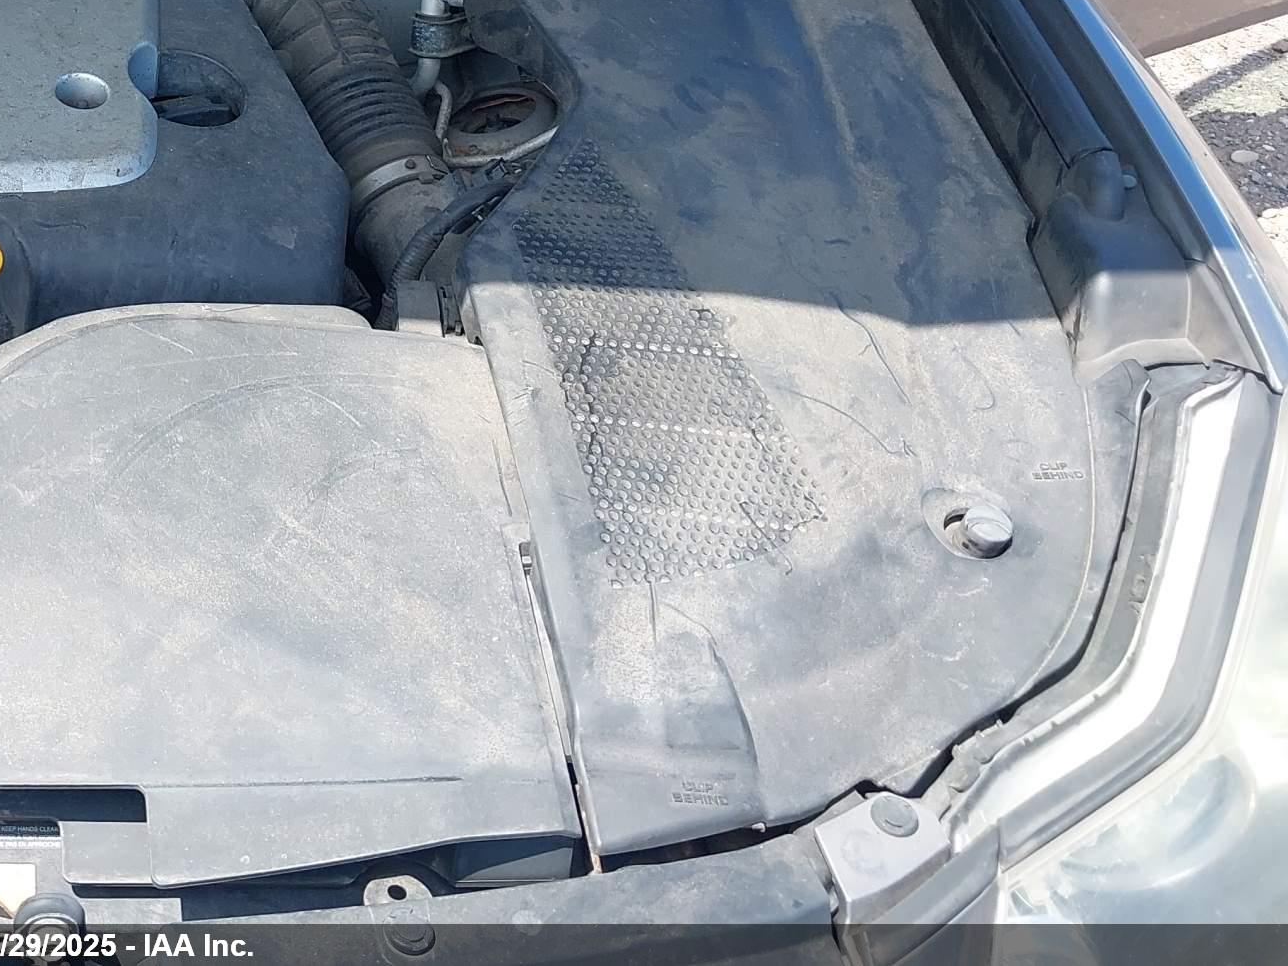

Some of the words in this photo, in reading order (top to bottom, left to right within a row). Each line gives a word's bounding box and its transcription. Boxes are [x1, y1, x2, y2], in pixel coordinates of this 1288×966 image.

[1039, 461, 1069, 471] CLIP
[1031, 470, 1085, 481] BEHIND
[681, 781, 715, 793] CLIP
[671, 791, 729, 806] BEHIND
[17, 825, 38, 834] HANDS
